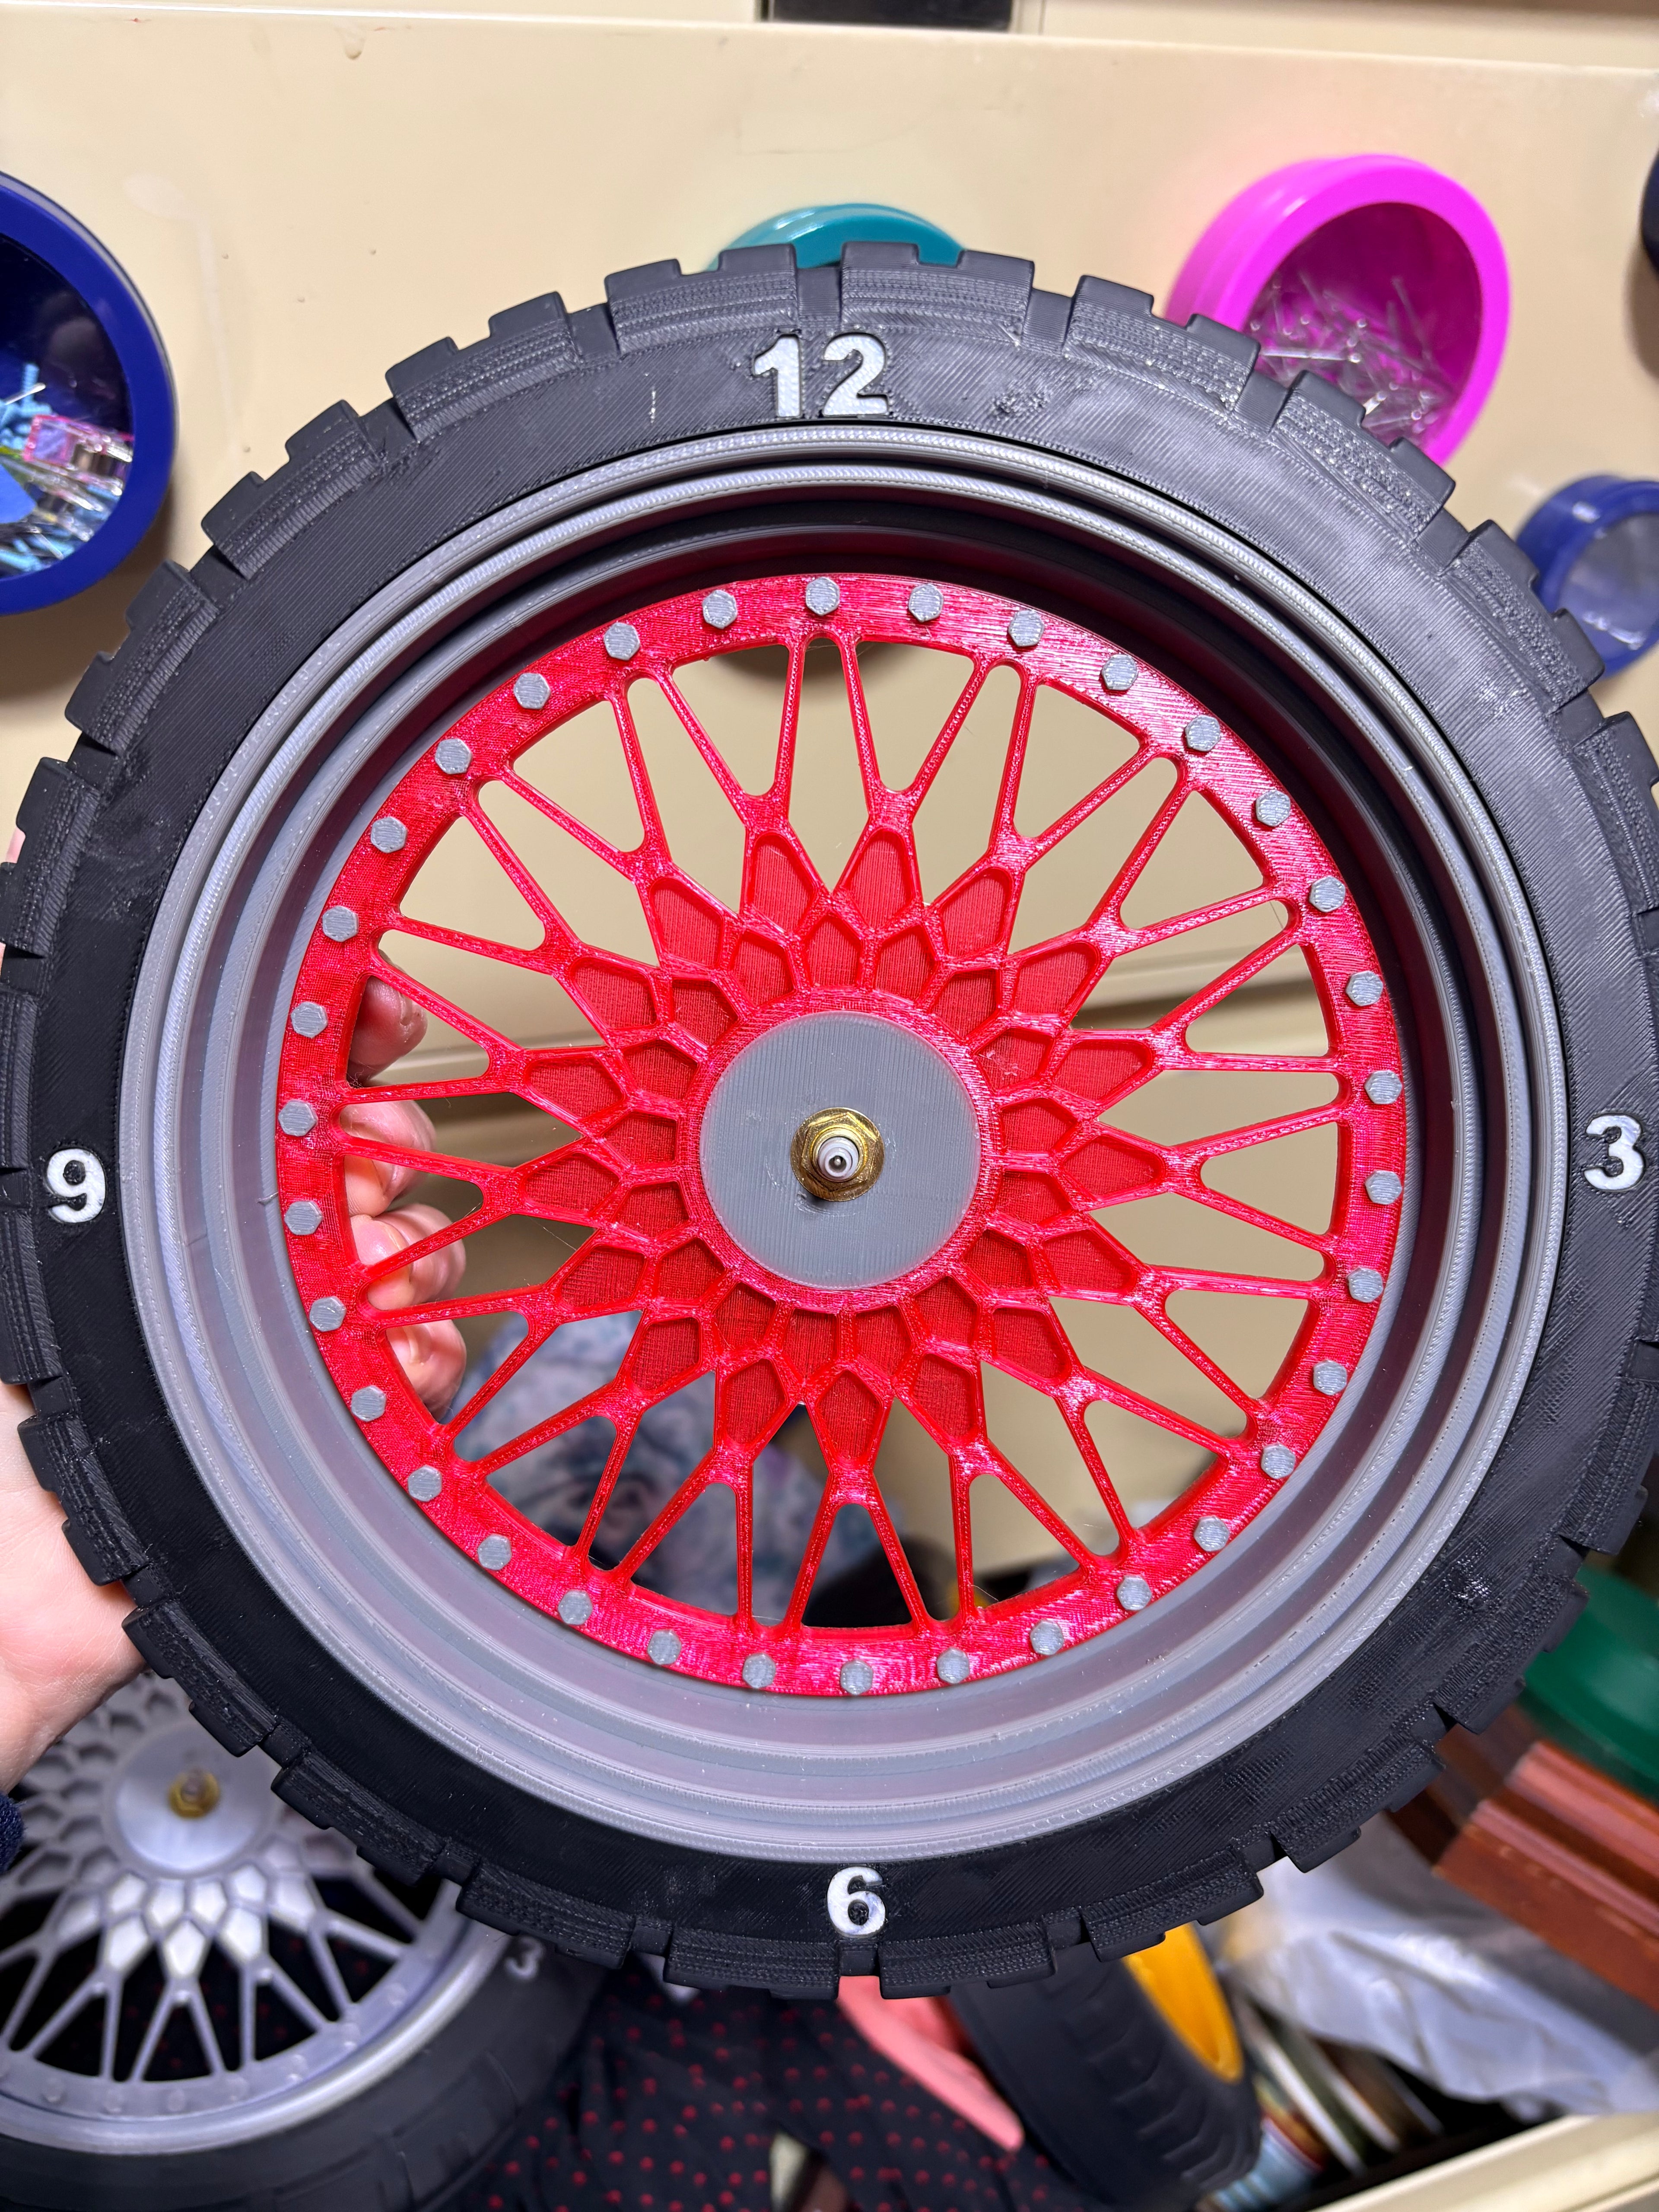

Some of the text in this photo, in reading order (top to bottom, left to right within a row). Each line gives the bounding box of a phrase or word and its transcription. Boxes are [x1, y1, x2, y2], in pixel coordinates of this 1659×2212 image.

[752, 333, 889, 418] 12
[46, 1147, 106, 1224] 9
[1584, 1114, 1645, 1191] 3
[827, 1866, 886, 1938] 6
[505, 1937, 543, 1980] 3
